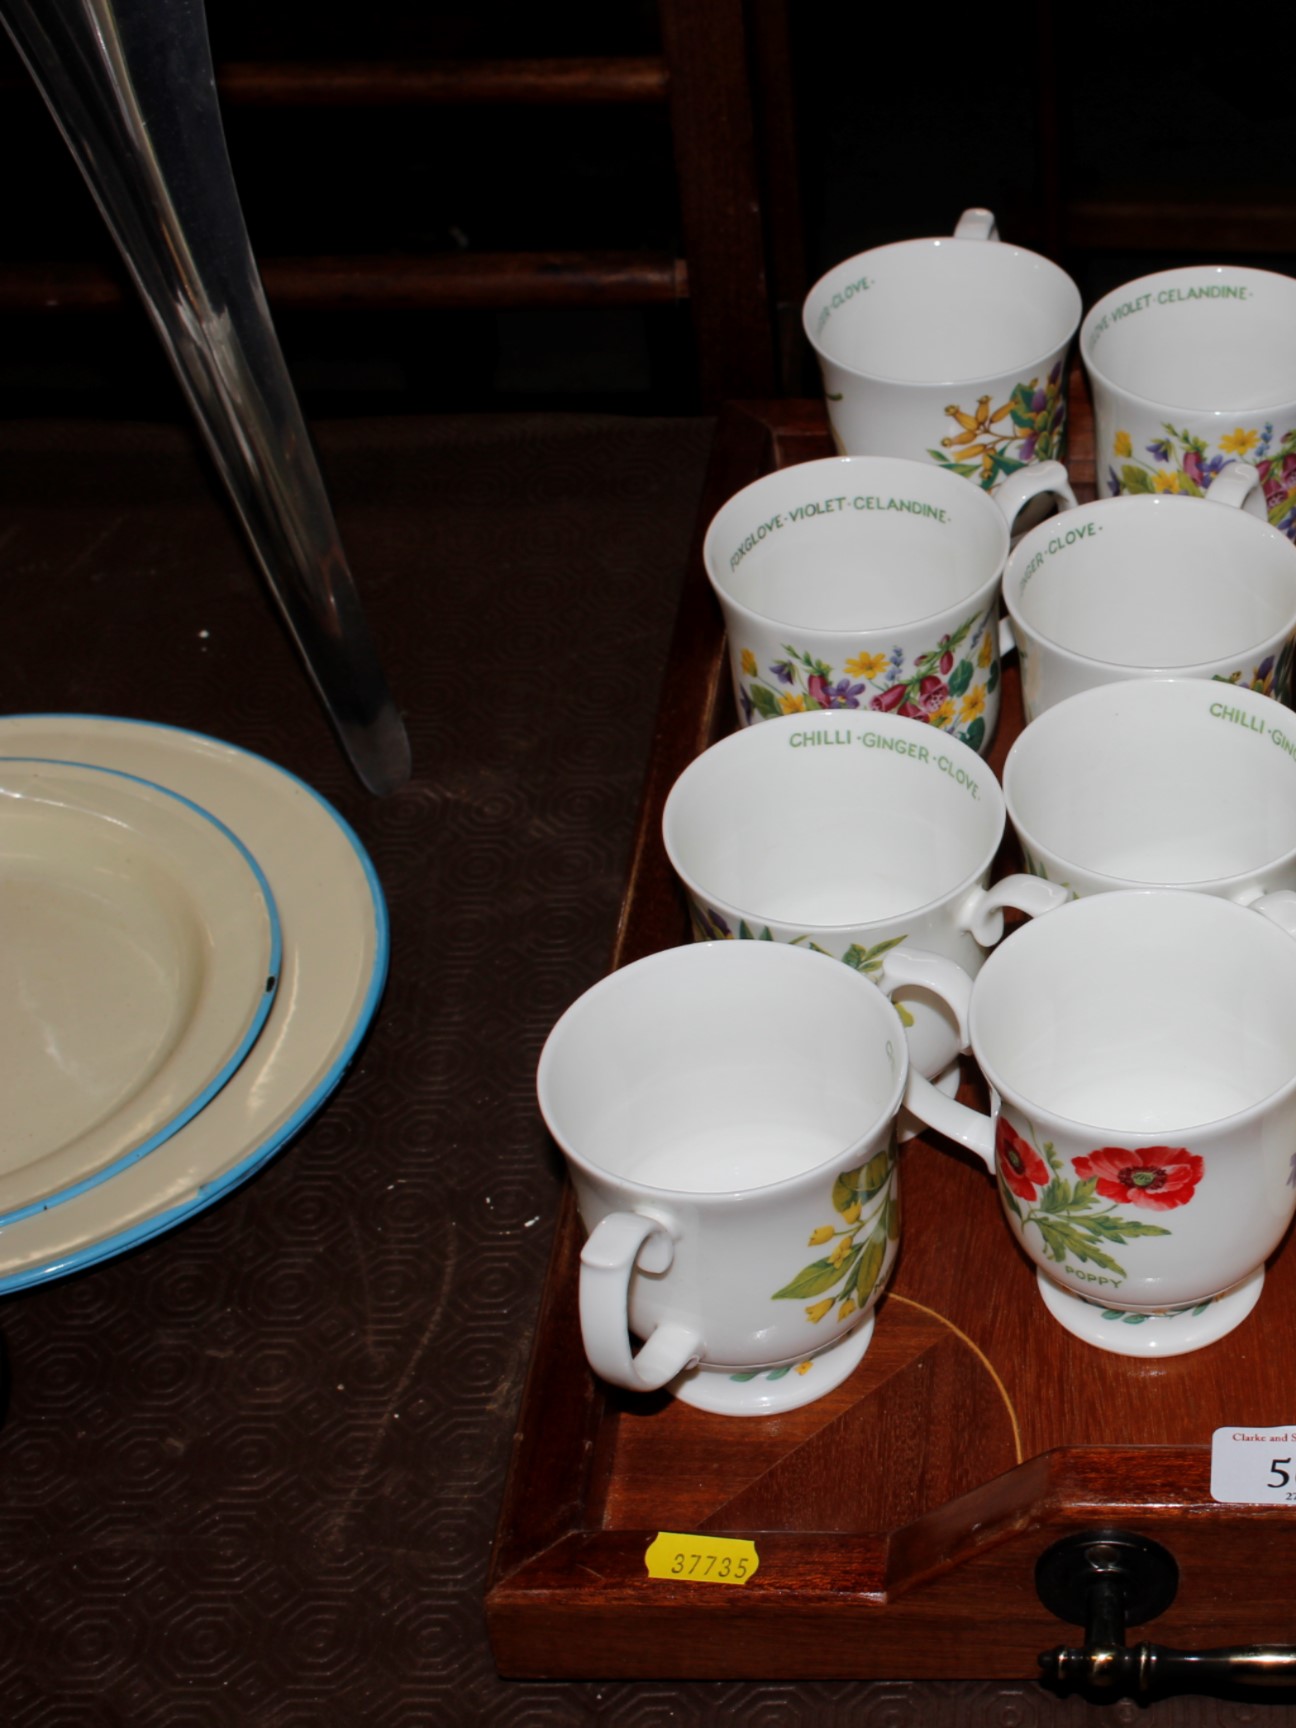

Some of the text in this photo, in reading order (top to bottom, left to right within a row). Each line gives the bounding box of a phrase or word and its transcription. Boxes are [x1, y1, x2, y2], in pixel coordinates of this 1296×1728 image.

[1065, 1264, 1122, 1289] POPPY
[1232, 1432, 1266, 1443] Clarke
[1269, 1432, 1288, 1443] and
[671, 1553, 749, 1579] 37735
